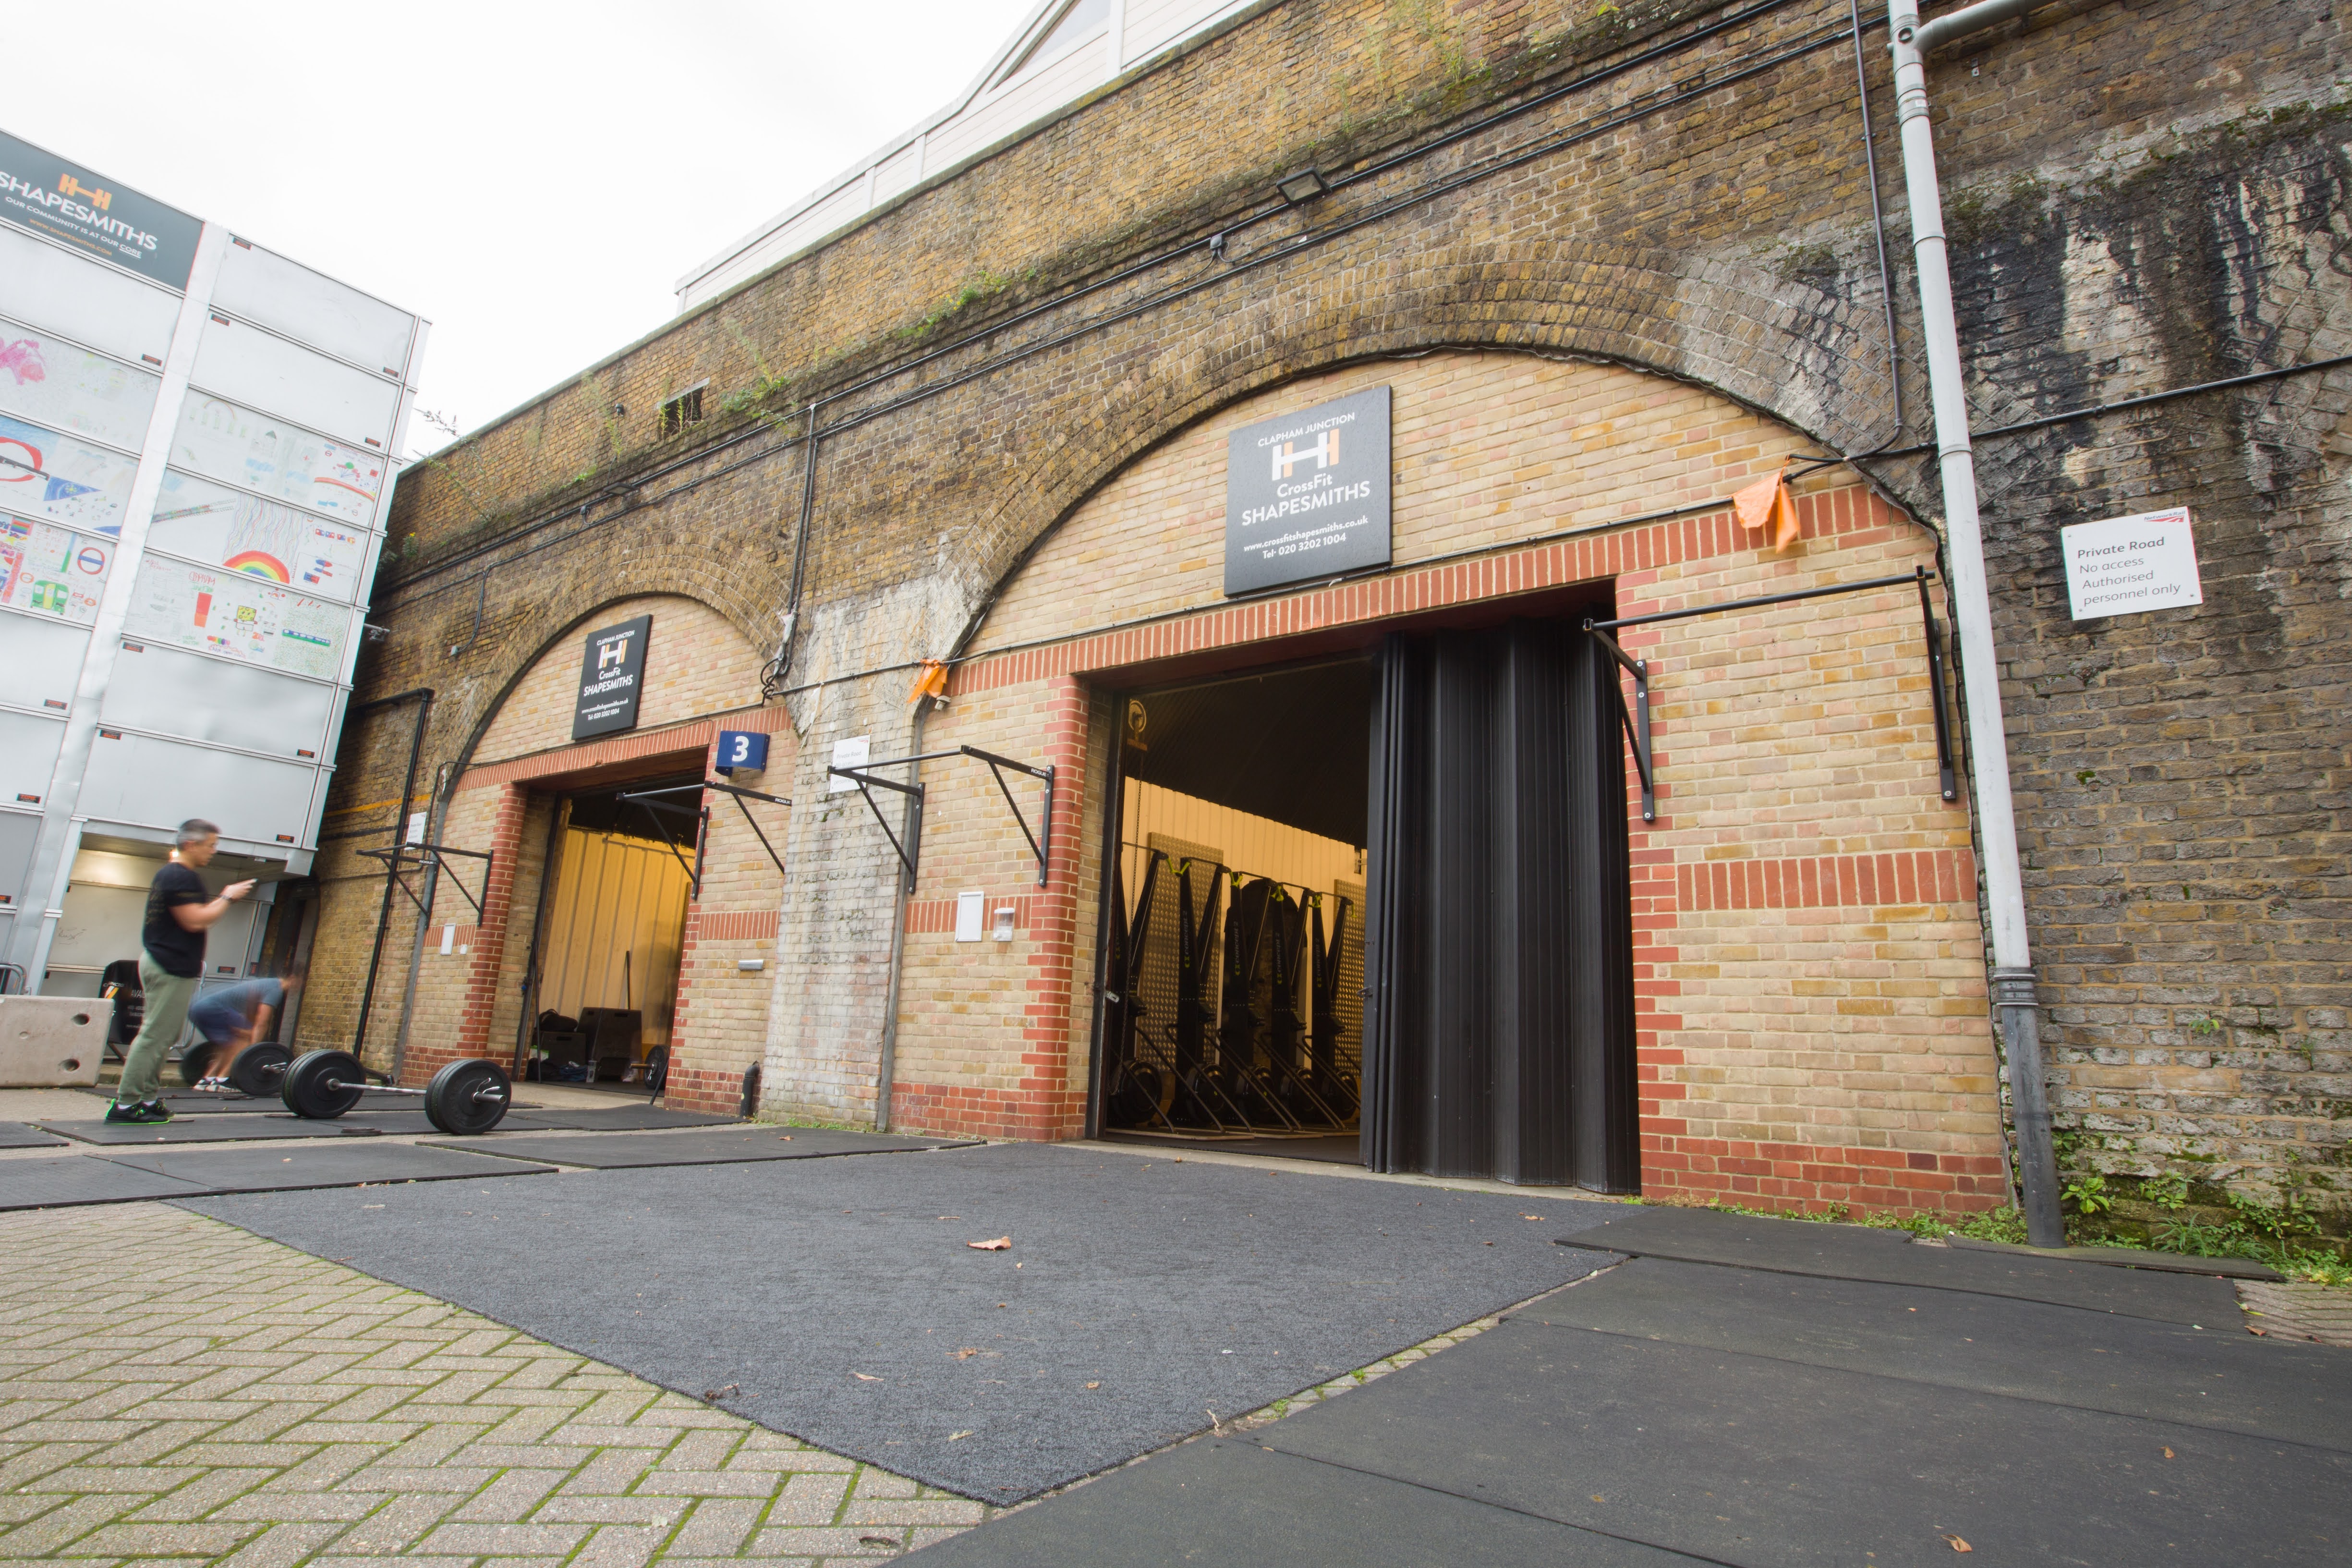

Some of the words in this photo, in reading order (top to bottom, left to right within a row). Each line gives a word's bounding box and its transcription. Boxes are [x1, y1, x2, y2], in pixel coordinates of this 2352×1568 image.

[0, 171, 158, 250] SHAPESMITHS
[5, 196, 26, 208] OUR
[26, 205, 80, 231] COMMUNITY
[87, 231, 100, 239] AT
[101, 235, 119, 247] OUR
[120, 244, 142, 258] CORE
[1258, 427, 1303, 447] CLAPHAM
[1305, 412, 1355, 434] JUNCTION
[1277, 473, 1333, 498] CrossFit
[1242, 480, 1370, 526] SHAPESMITHS
[1244, 515, 1368, 552] www.crossfitshapesmiths.co.uk
[1278, 544, 1297, 556] 020
[1298, 539, 1321, 551] 3202
[1323, 532, 1346, 546] 1004
[2078, 545, 2125, 559] Private
[2129, 536, 2165, 550] Road
[2080, 564, 2097, 573] No
[2102, 558, 2144, 570] access
[2082, 570, 2154, 589] Authorised
[2084, 587, 2147, 607] personnel
[2152, 583, 2181, 595] only
[596, 635, 615, 645] CLAPHAM
[615, 630, 635, 641] JUNCTION
[583, 674, 633, 696] SHAPESMITHS
[599, 667, 621, 680] CrossFit
[732, 735, 749, 762] 3
[1031, 768, 1047, 777] ROGUE
